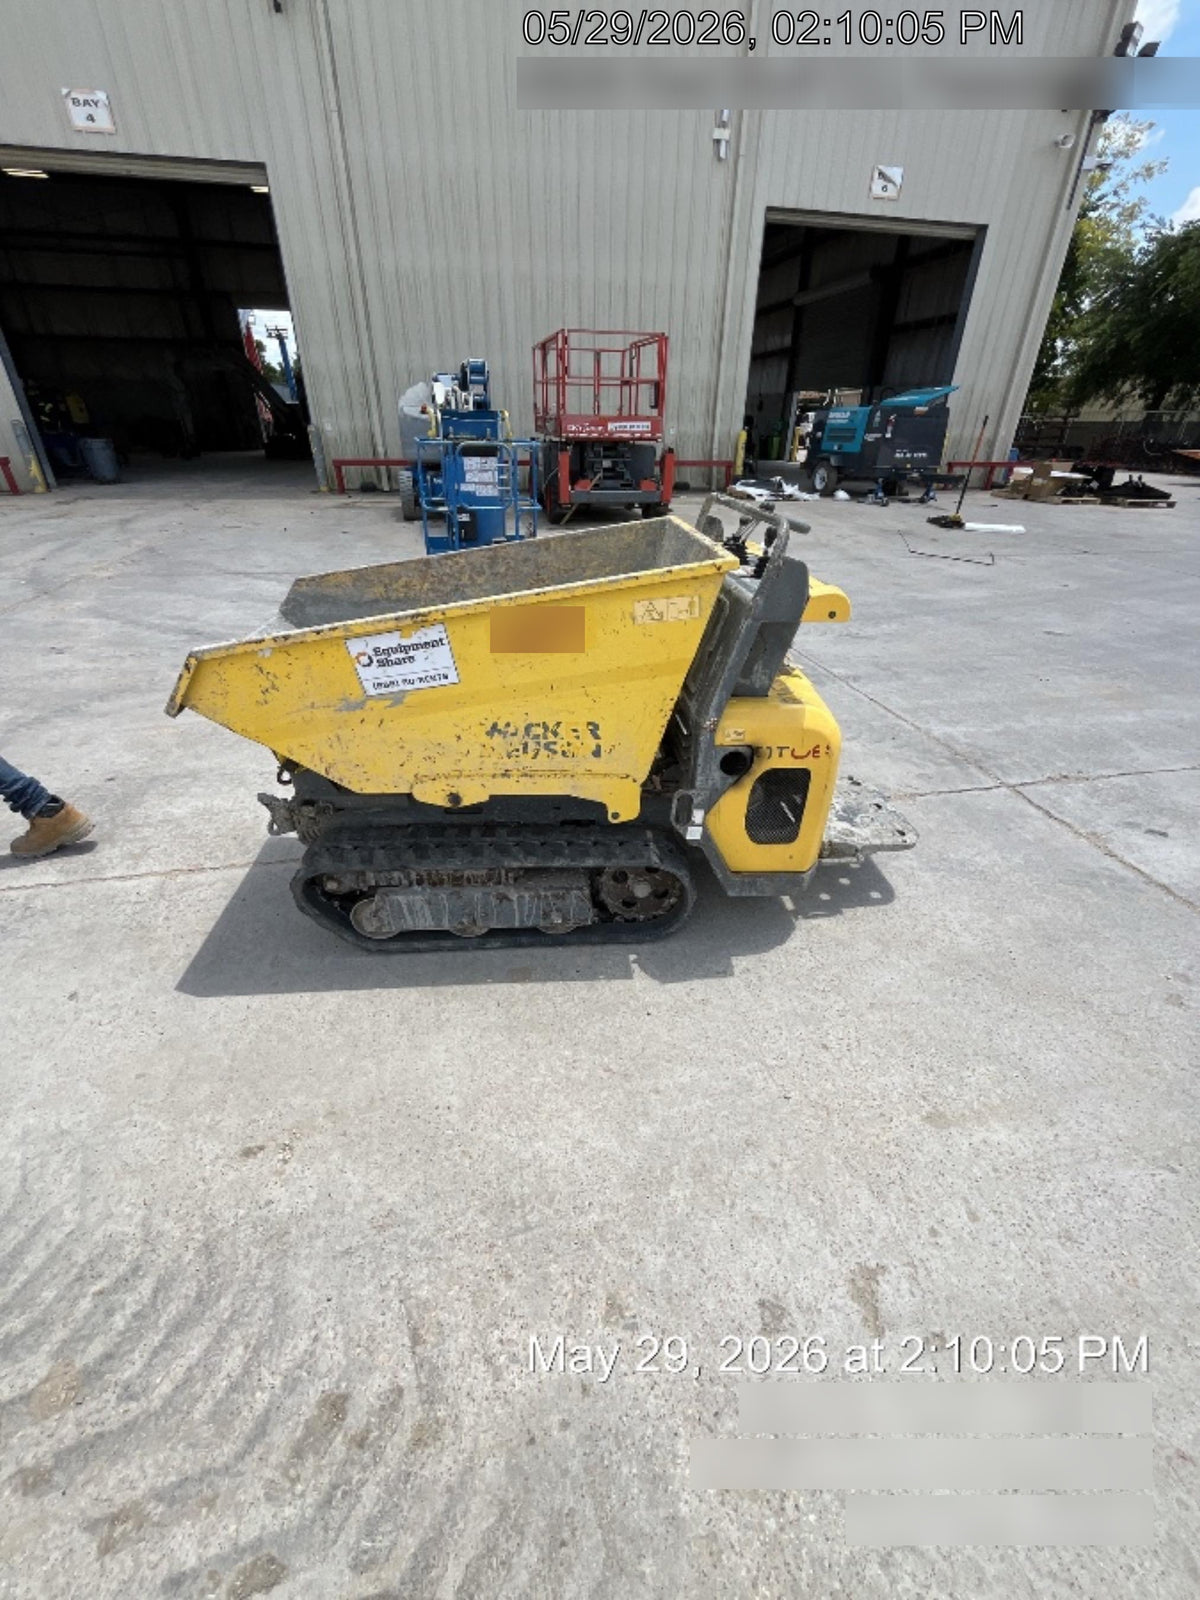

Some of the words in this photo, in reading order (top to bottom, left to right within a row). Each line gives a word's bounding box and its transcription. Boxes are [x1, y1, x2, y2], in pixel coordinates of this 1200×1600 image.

[71, 97, 100, 108] BAY
[86, 113, 96, 123] 4
[881, 184, 888, 193] 6
[372, 637, 446, 659] Equipment
[376, 654, 416, 669] Share
